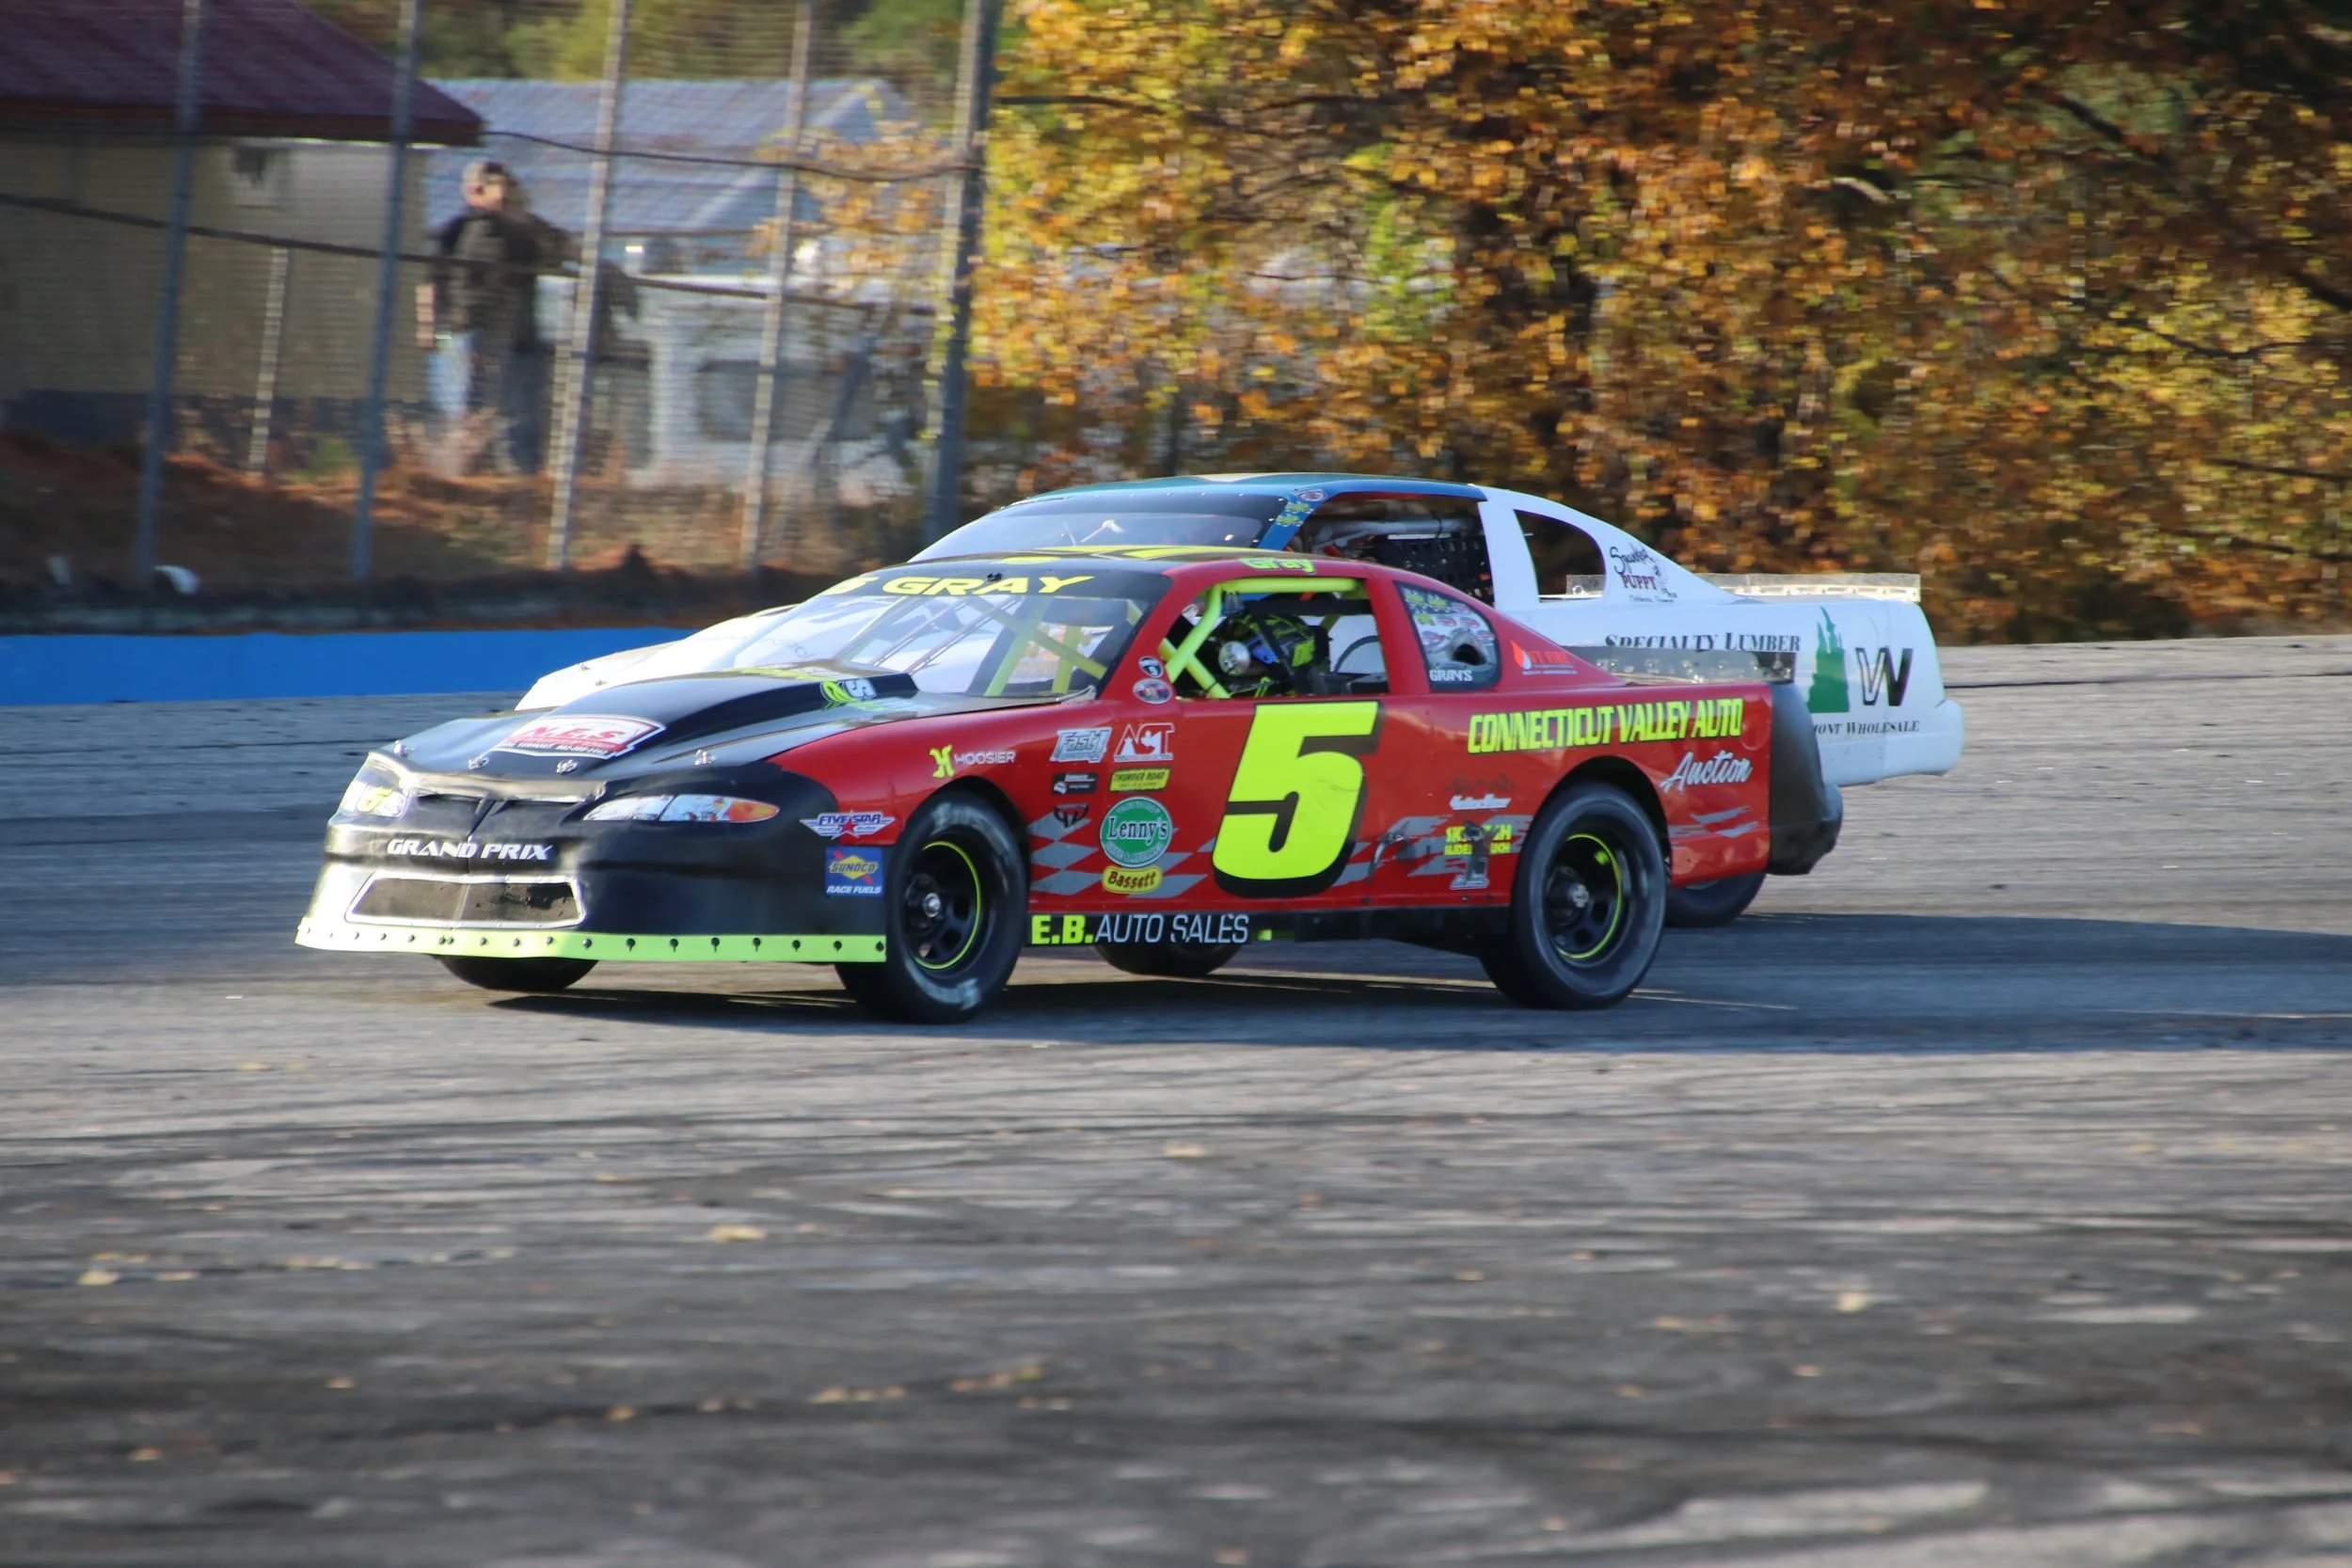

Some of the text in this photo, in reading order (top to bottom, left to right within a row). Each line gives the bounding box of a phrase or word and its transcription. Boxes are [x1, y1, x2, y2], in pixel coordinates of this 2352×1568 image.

[1239, 558, 1316, 575] Gray
[882, 576, 1095, 595] GRAY
[1623, 574, 1658, 591] PUPPY
[1724, 632, 1801, 652] LUMBER
[1468, 698, 1744, 753] CONNECTICUT VALLEY AUTO
[1846, 721, 1920, 735] WHOLESALE
[954, 751, 1016, 765] HOOSIER
[1660, 750, 1754, 794] Auction
[1212, 701, 1381, 881] 5
[818, 814, 882, 826] FIVE STAR
[1106, 816, 1168, 846] Lenny's
[387, 838, 553, 861] GRAND PRIX
[830, 862, 876, 874] SUNOCO
[1107, 870, 1157, 889] Bassett
[826, 885, 882, 895] RACE FUELS
[1031, 913, 1249, 944] E.B. AUTO SALES
